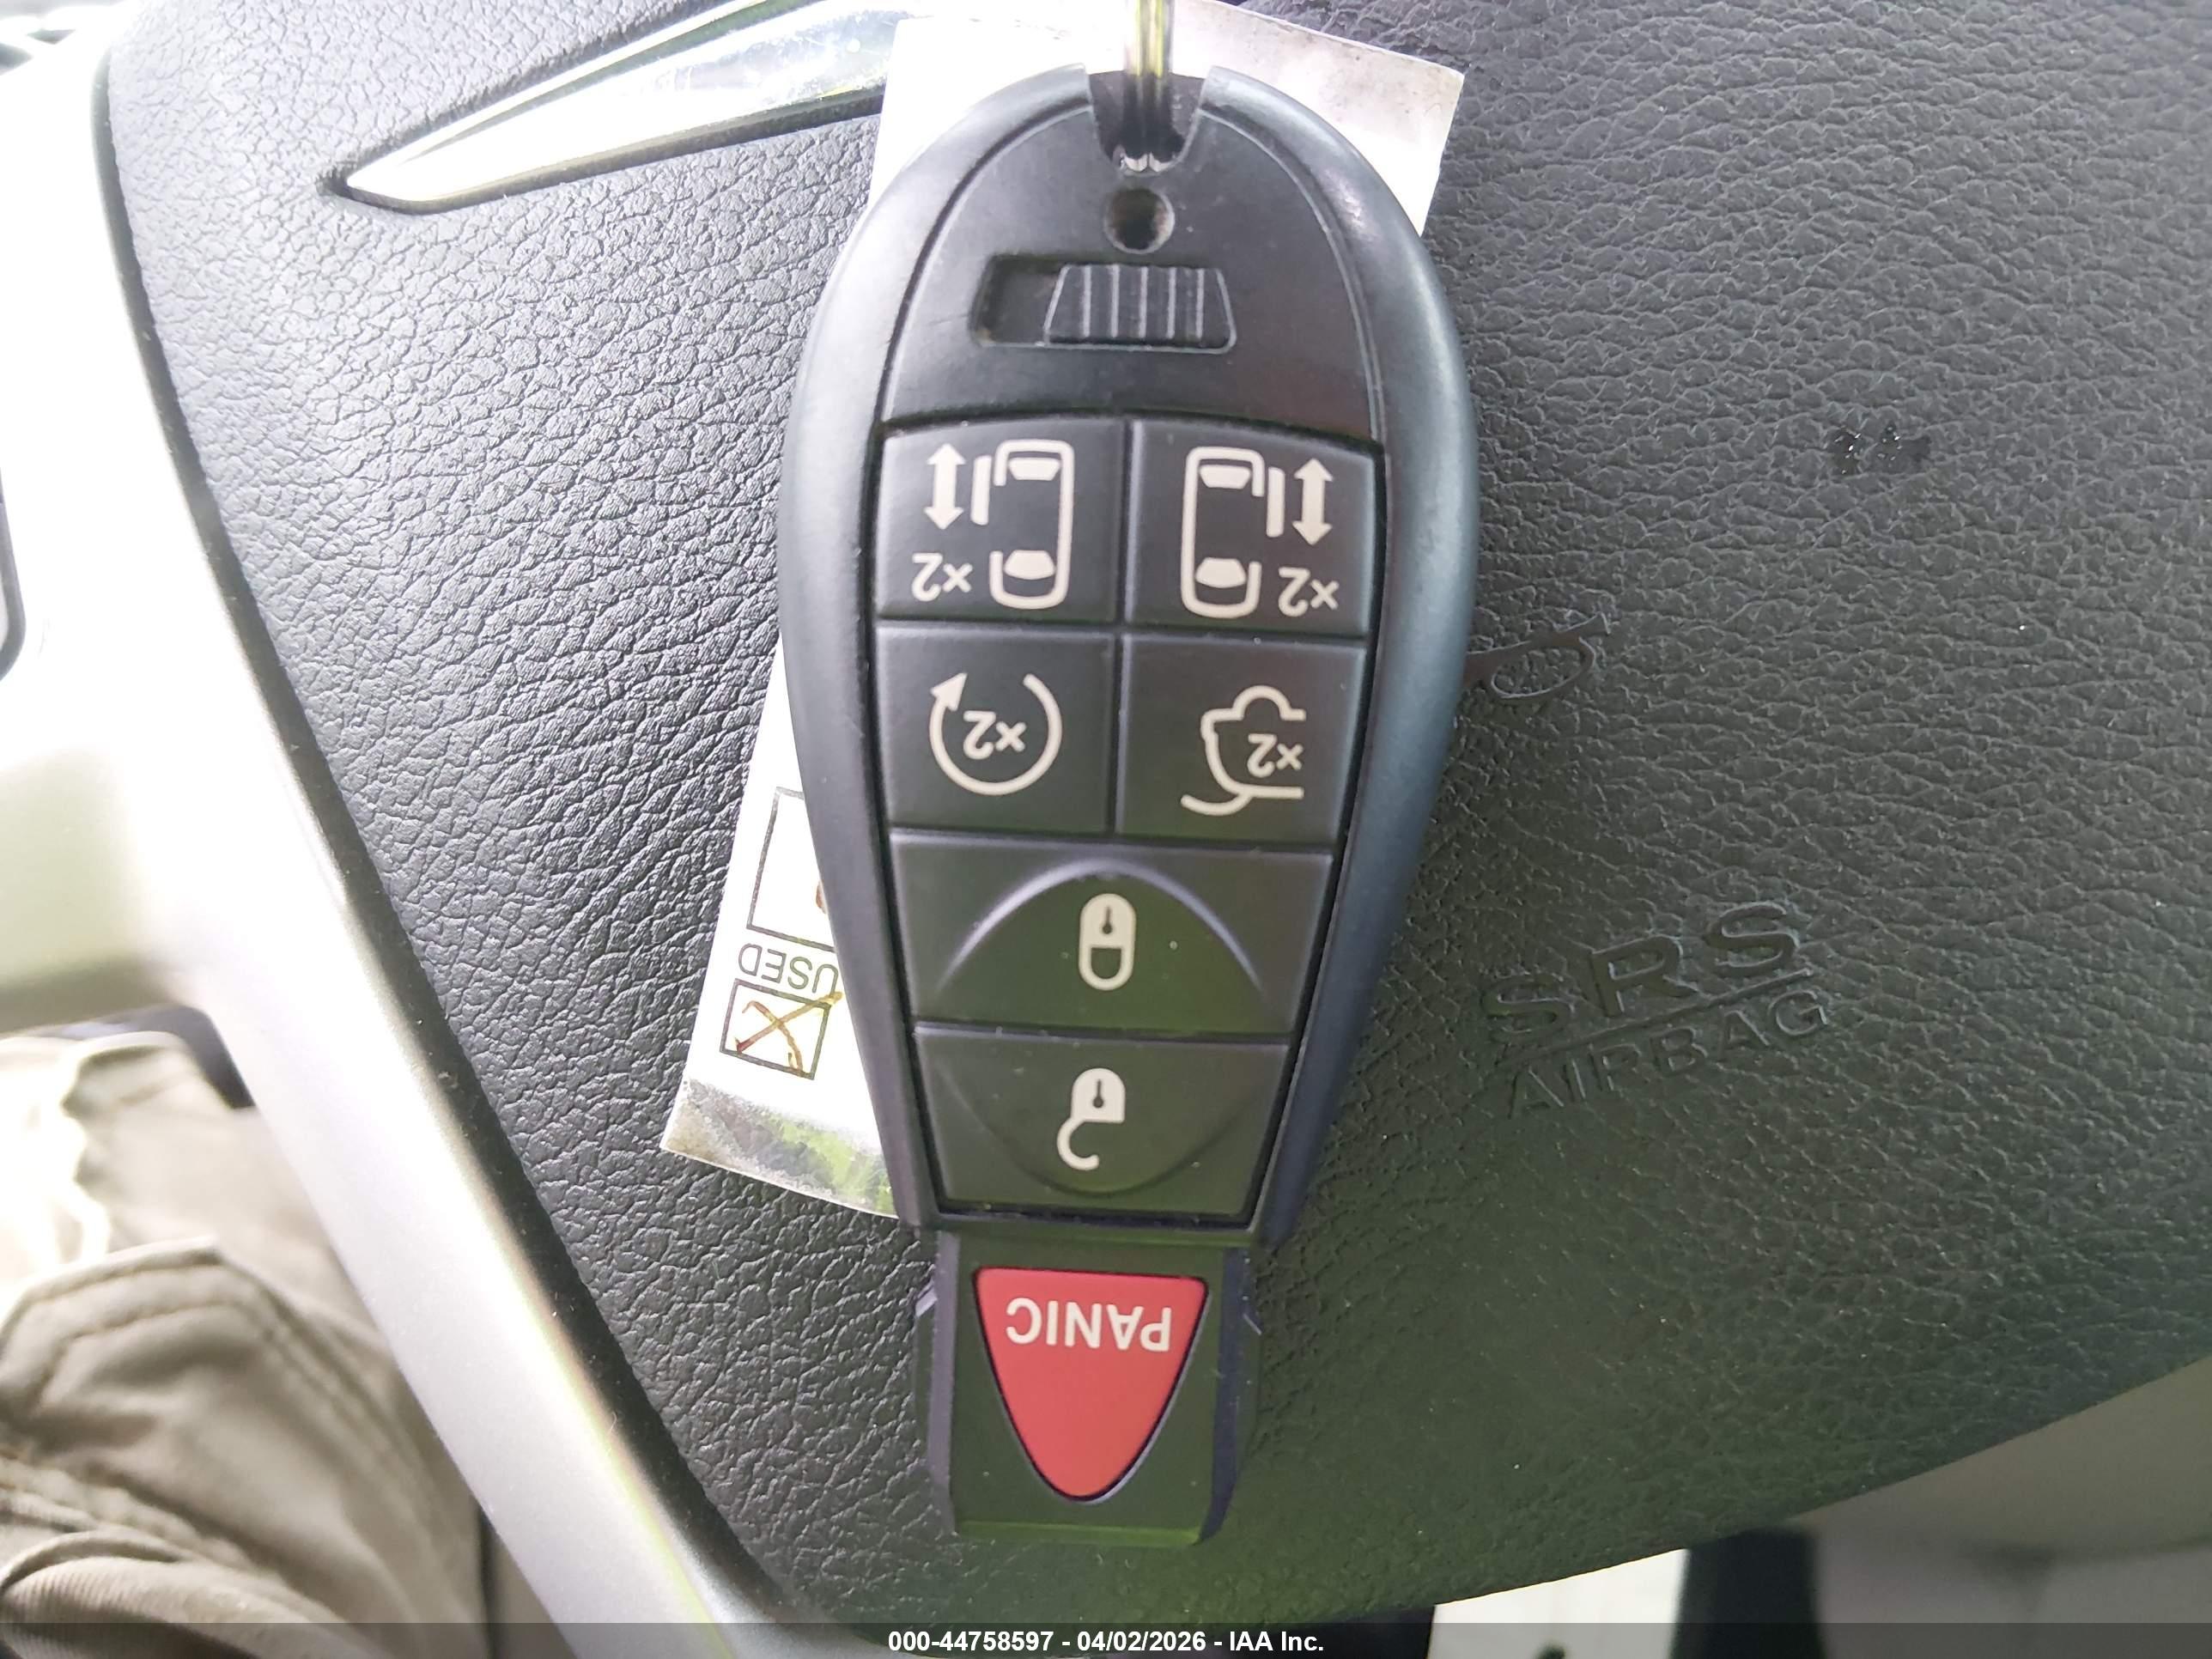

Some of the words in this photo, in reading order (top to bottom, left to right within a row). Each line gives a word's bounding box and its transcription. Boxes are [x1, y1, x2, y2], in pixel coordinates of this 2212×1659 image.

[738, 942, 839, 996] USED
[1508, 989, 1829, 1120] AIRBAG
[1006, 1297, 1171, 1352] PANIC
